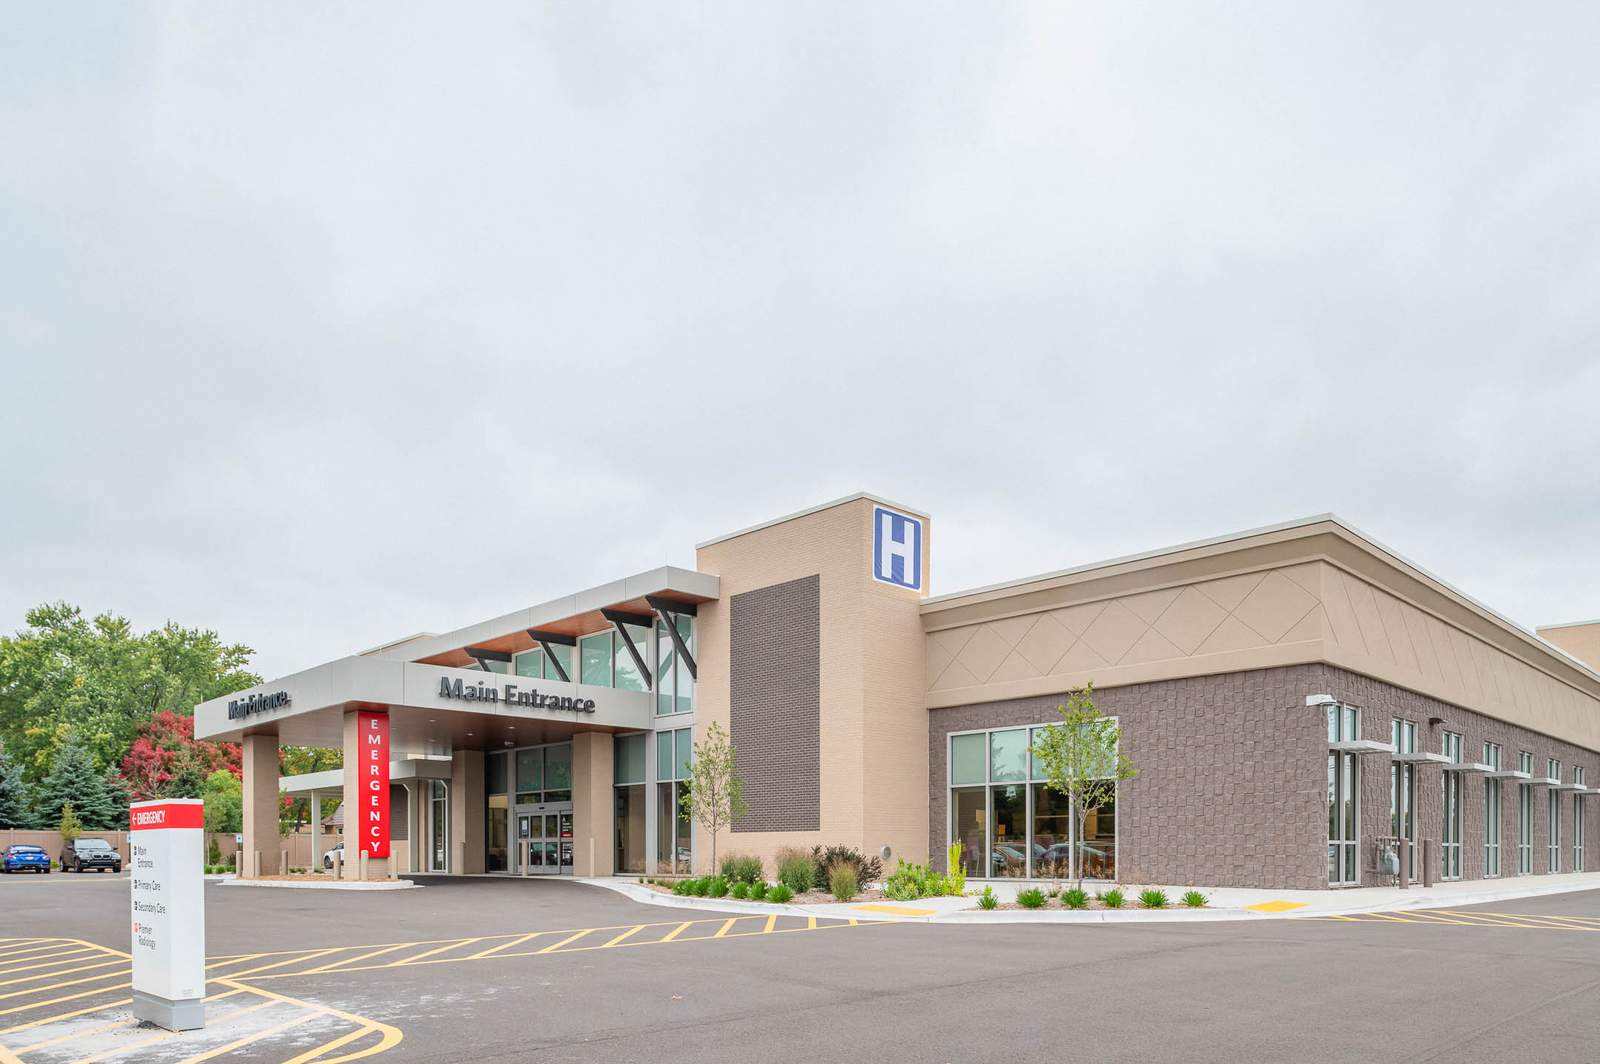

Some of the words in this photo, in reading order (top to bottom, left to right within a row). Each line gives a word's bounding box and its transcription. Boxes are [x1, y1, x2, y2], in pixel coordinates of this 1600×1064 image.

[881, 513, 915, 585] H
[228, 698, 249, 720] Main
[248, 690, 288, 715] Entrance
[440, 676, 498, 703] Main
[504, 684, 596, 714] Entrance
[368, 719, 381, 853] EMERGENCY
[137, 810, 166, 825] EMERGENCY
[152, 880, 161, 891] Care
[157, 902, 166, 914] Care
